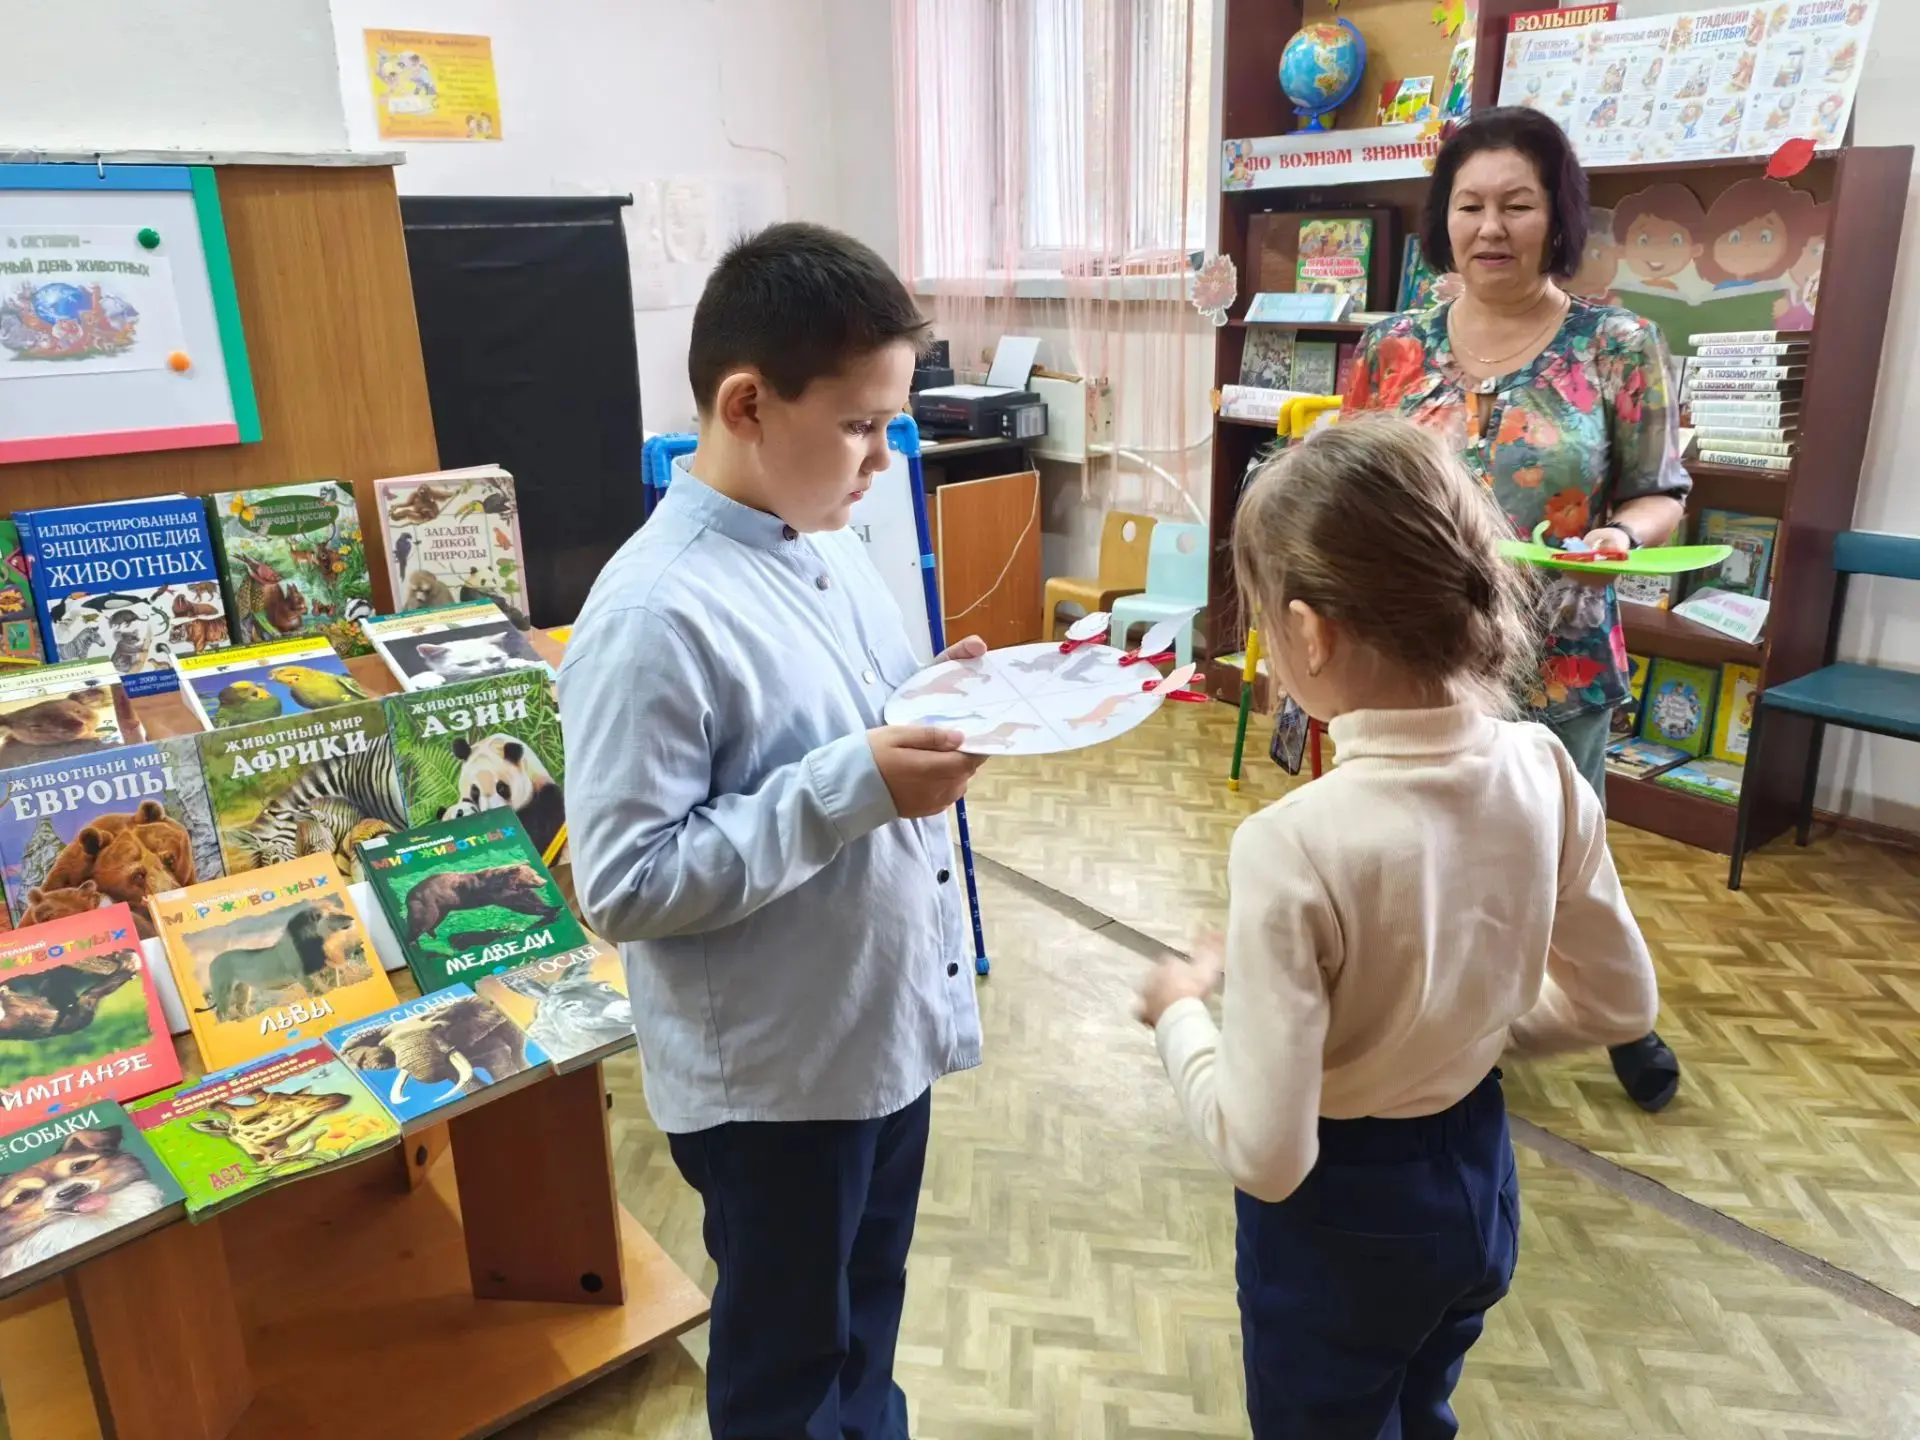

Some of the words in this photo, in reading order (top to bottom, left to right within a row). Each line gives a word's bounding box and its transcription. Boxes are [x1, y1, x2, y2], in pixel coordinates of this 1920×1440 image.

[1514, 6, 1610, 32] БОЛЬШИЕ
[1695, 11, 1750, 30] ТРАДИЦИИ
[1700, 26, 1747, 44] СЕНТЯБРЯ
[37, 259, 73, 274] ДЕНЬ
[75, 259, 150, 277] ЖИВОТНЫХ
[1715, 369, 1748, 378] ПОЗНАЮ
[38, 511, 199, 539] ИЛЛЮСТРИРОВАННАЯ
[424, 525, 480, 538] ЗАГАДКИ
[41, 528, 202, 560] ЭНЦИКЛОПЕДИЯ
[423, 548, 488, 563] ПРИРОДЫ
[431, 536, 477, 549] ДИКОЙ
[46, 550, 208, 588] ЖИВОТНЫХ
[411, 687, 499, 715] ЖИВОТНЫЙ
[502, 683, 532, 698] МИР
[421, 698, 530, 738] АЗИИ
[224, 720, 326, 755] ЖИВОТНЫЙ
[331, 715, 364, 732] МИР
[230, 730, 370, 780] АФРИКИ
[10, 758, 127, 793] ЖИВОТНЫЙ
[133, 751, 171, 769] МИР
[10, 766, 177, 821] ЕВРОПЫ
[371, 852, 413, 869] МИР
[419, 826, 516, 859] ЖИВОТНЫХ
[218, 874, 329, 913] ЖИВОТНЫХ
[446, 929, 555, 976] МЕДВЕДИ
[539, 945, 603, 973] ОСЛЫ
[259, 996, 335, 1036] ЛЬВЫ
[389, 991, 458, 1023] СЛОНЫ
[9, 1109, 102, 1154] СОБАКИ
[208, 1163, 246, 1189] АСТ
